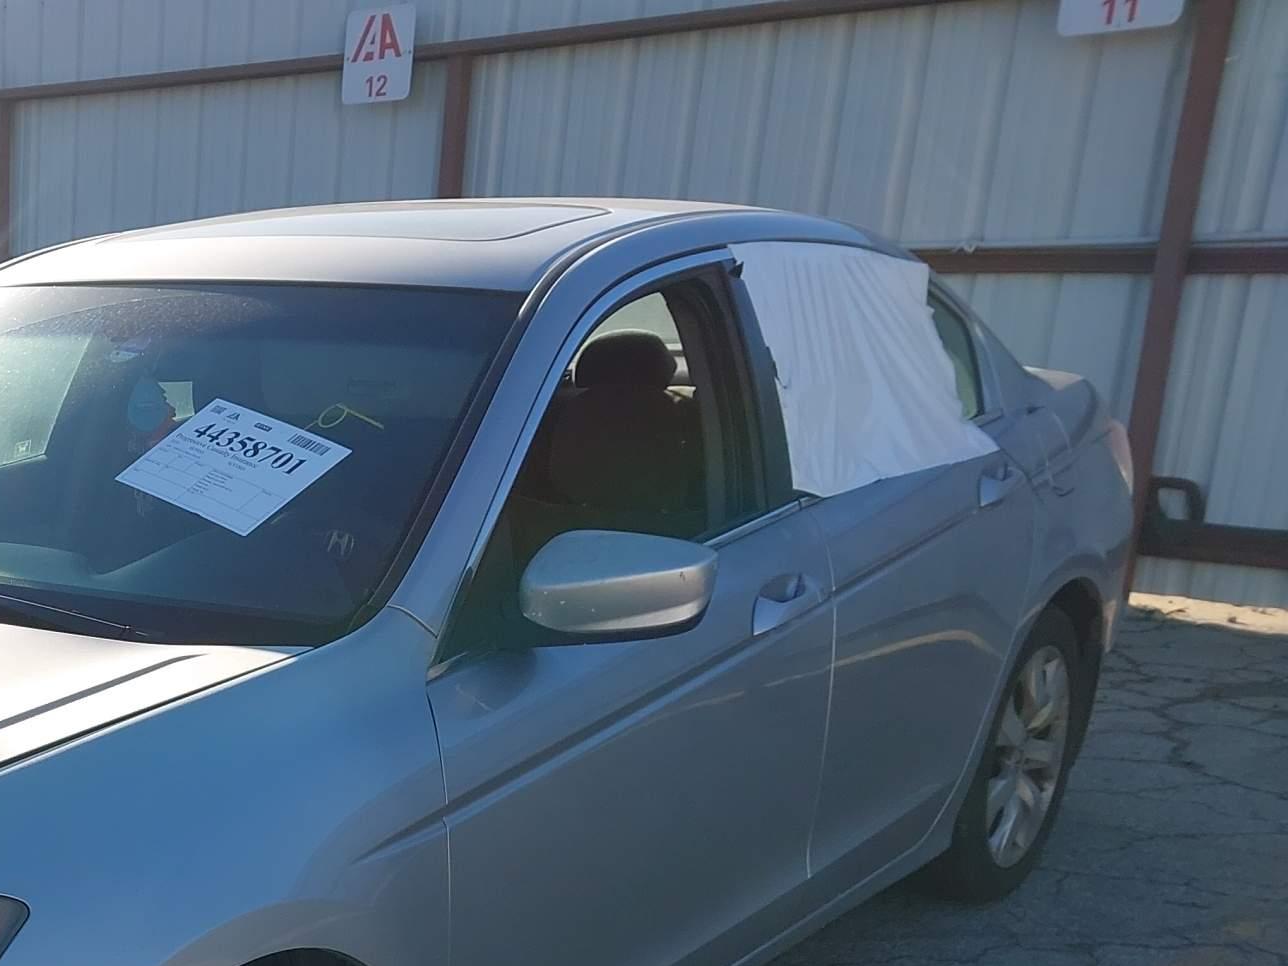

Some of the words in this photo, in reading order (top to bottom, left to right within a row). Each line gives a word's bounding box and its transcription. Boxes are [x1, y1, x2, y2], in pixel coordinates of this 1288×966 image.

[1102, 0, 1138, 25] 11
[366, 75, 388, 97] 12
[193, 423, 307, 475] 44358701
